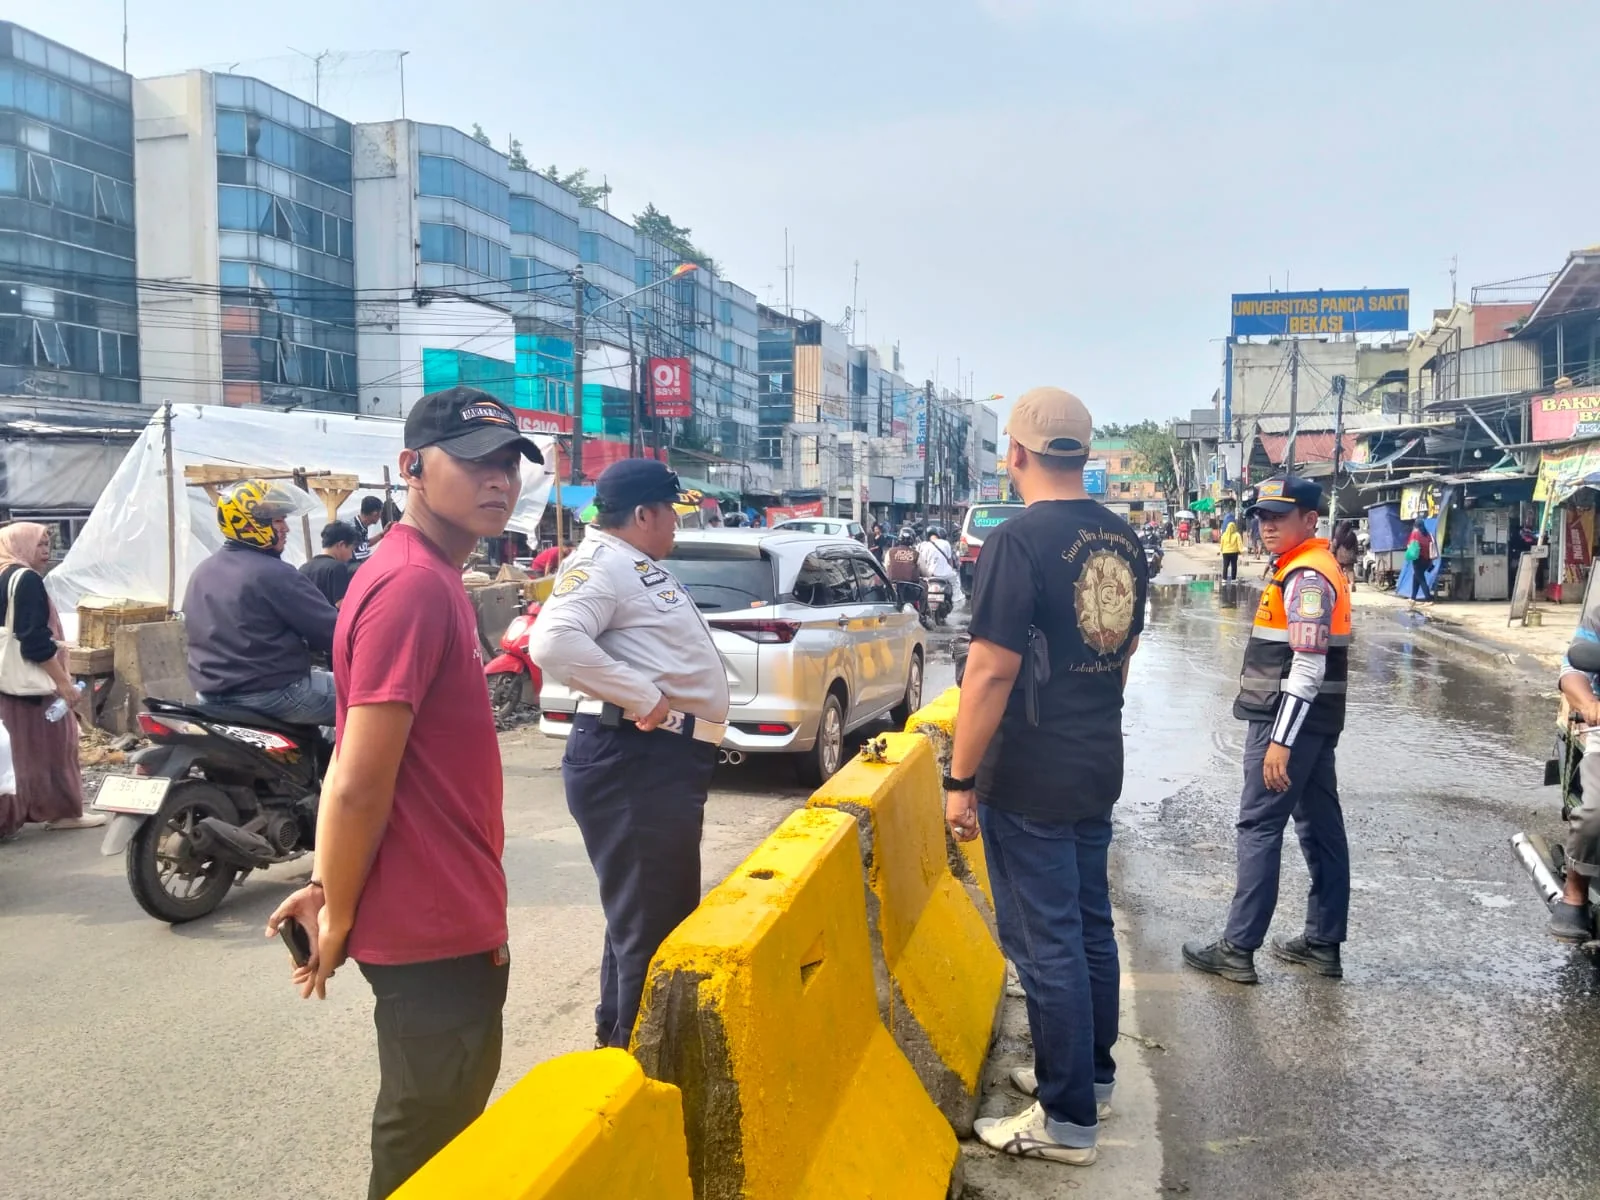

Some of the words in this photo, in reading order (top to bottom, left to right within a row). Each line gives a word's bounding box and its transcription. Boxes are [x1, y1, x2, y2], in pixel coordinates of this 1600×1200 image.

[1233, 298, 1317, 316] UNIVERSITAS
[1320, 296, 1364, 313] PANCA
[1368, 294, 1408, 311] SAKTI
[1289, 315, 1344, 333] BEKASI
[654, 364, 680, 387] O!
